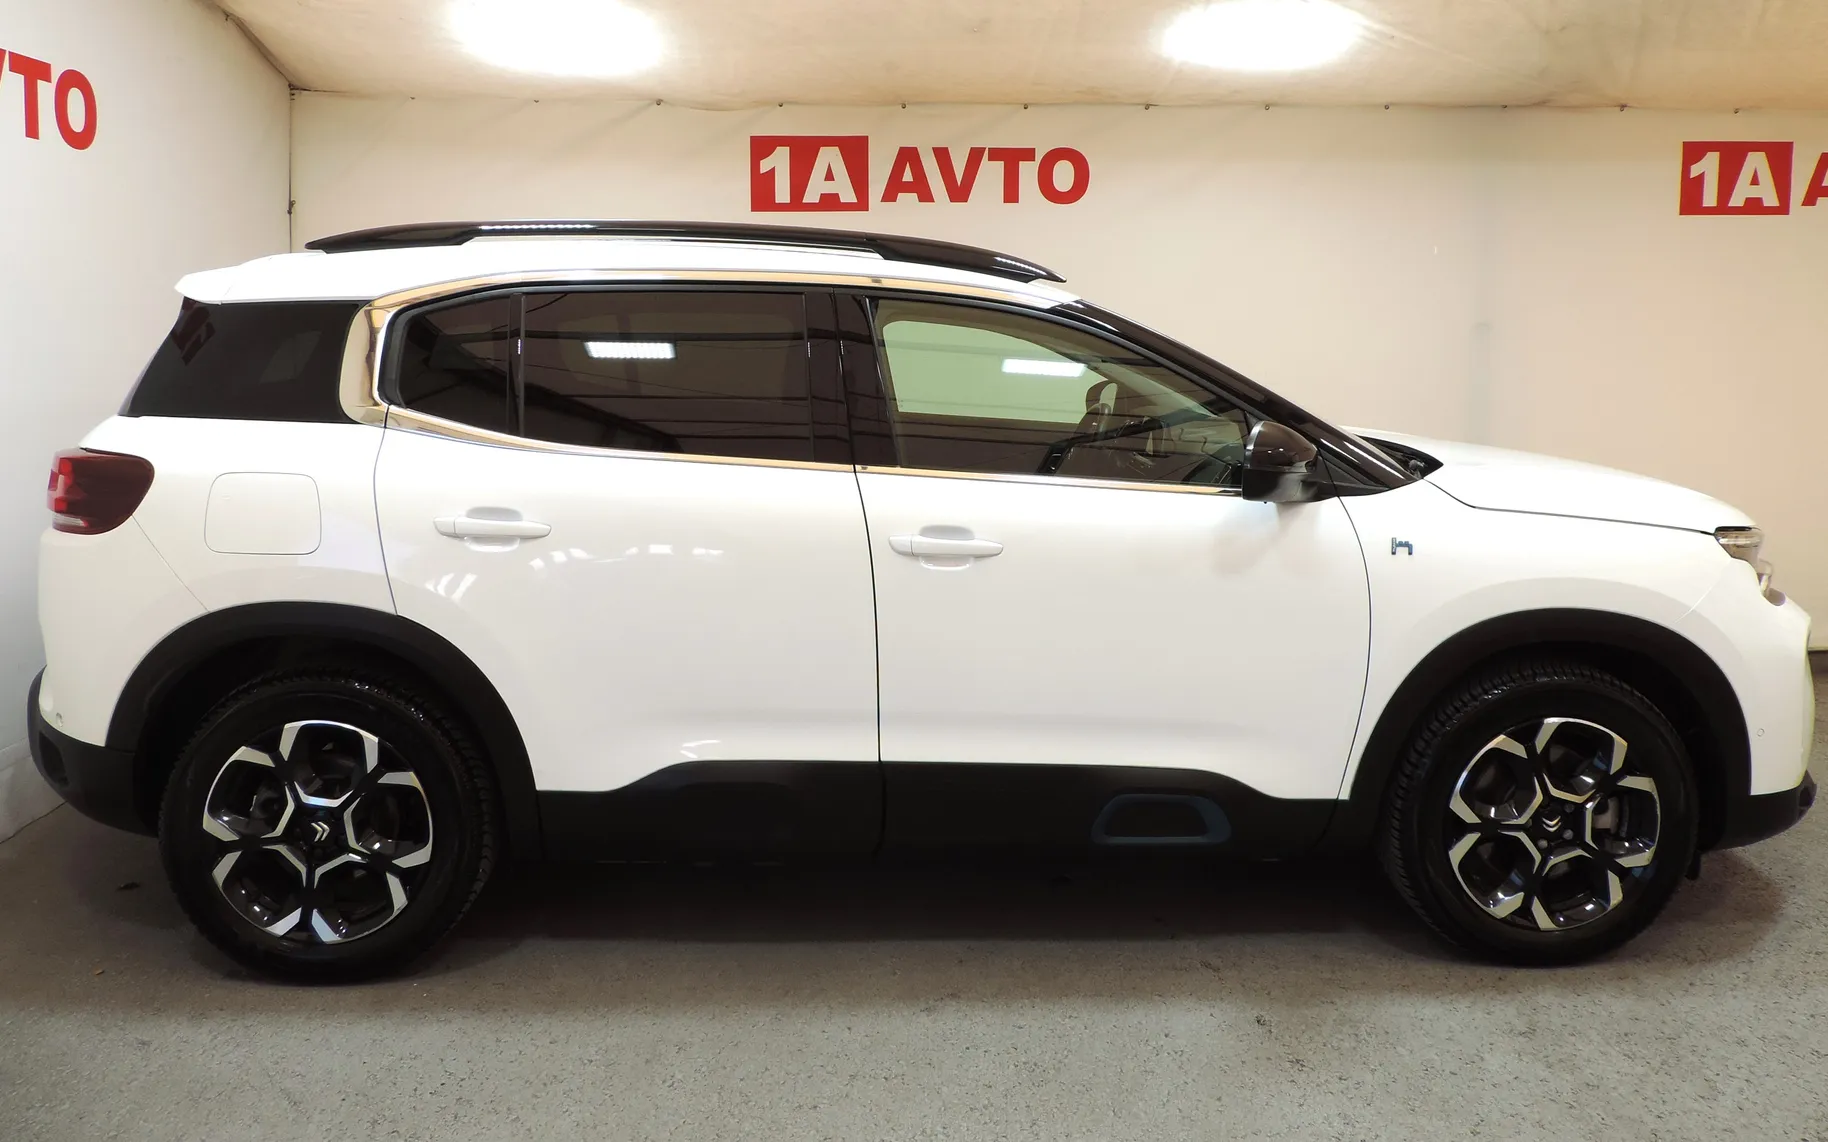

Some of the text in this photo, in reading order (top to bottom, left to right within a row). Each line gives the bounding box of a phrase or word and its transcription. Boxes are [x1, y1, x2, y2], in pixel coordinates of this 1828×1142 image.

[0, 48, 97, 151] TO
[759, 146, 1090, 205] 1A AVTO
[1689, 151, 1780, 207] 1A
